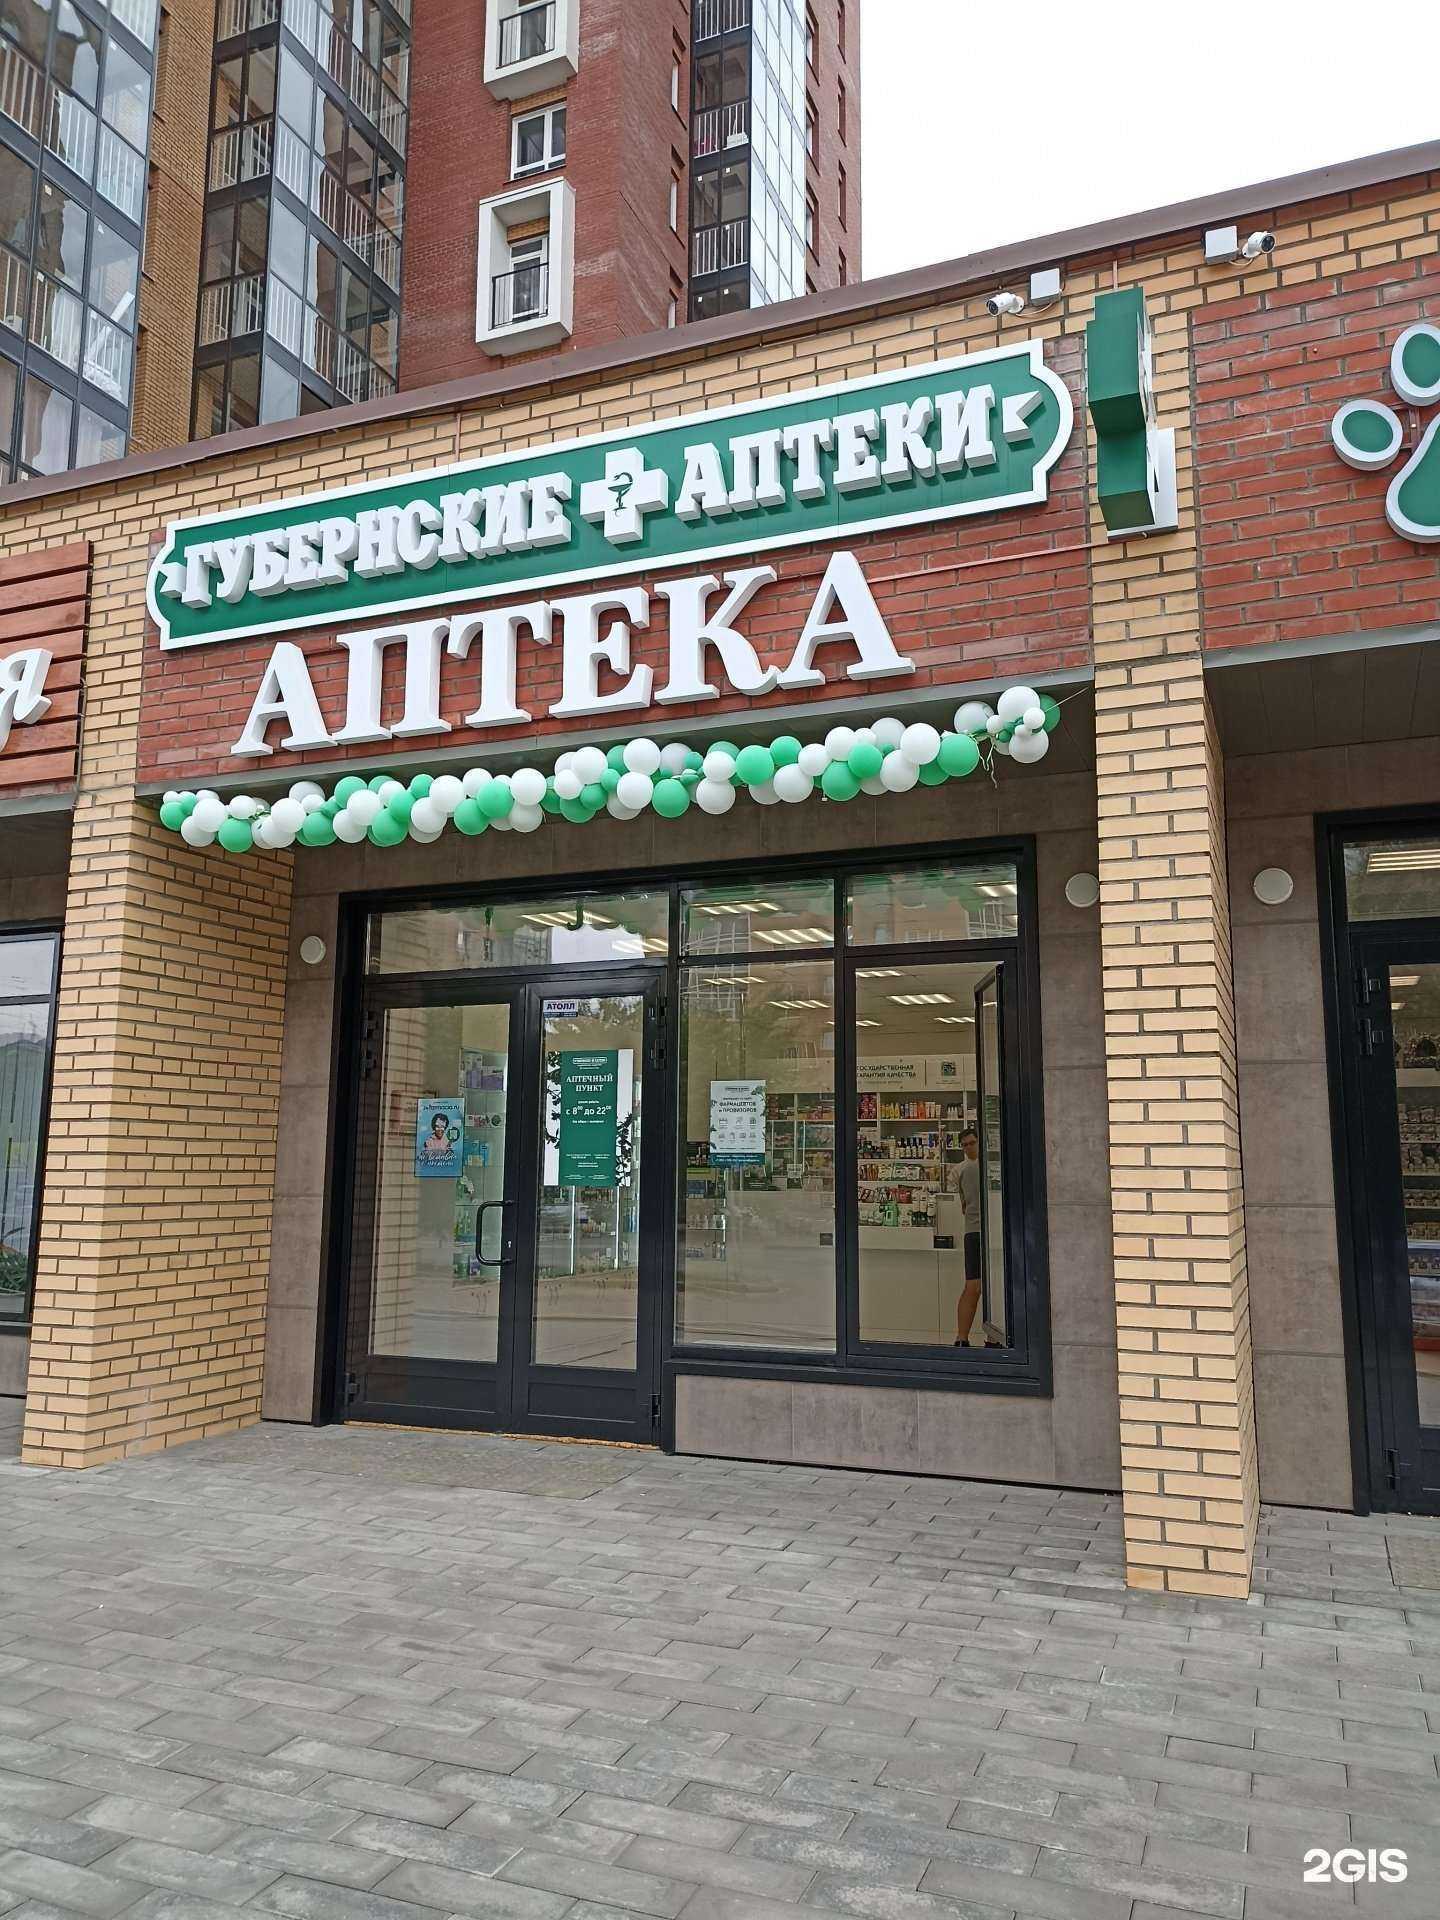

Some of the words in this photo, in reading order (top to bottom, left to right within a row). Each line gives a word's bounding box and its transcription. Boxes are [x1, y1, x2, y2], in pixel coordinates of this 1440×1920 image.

[181, 472, 572, 608] ГУБЕРНСКИЕ
[675, 384, 996, 521] АПТЕКИ
[231, 551, 916, 757] АПТЕКА
[546, 1002, 575, 1010] АТОЛЛ
[566, 1073, 613, 1083] АПТЕЧНЫЙ
[575, 1084, 604, 1092] ПУНКТ
